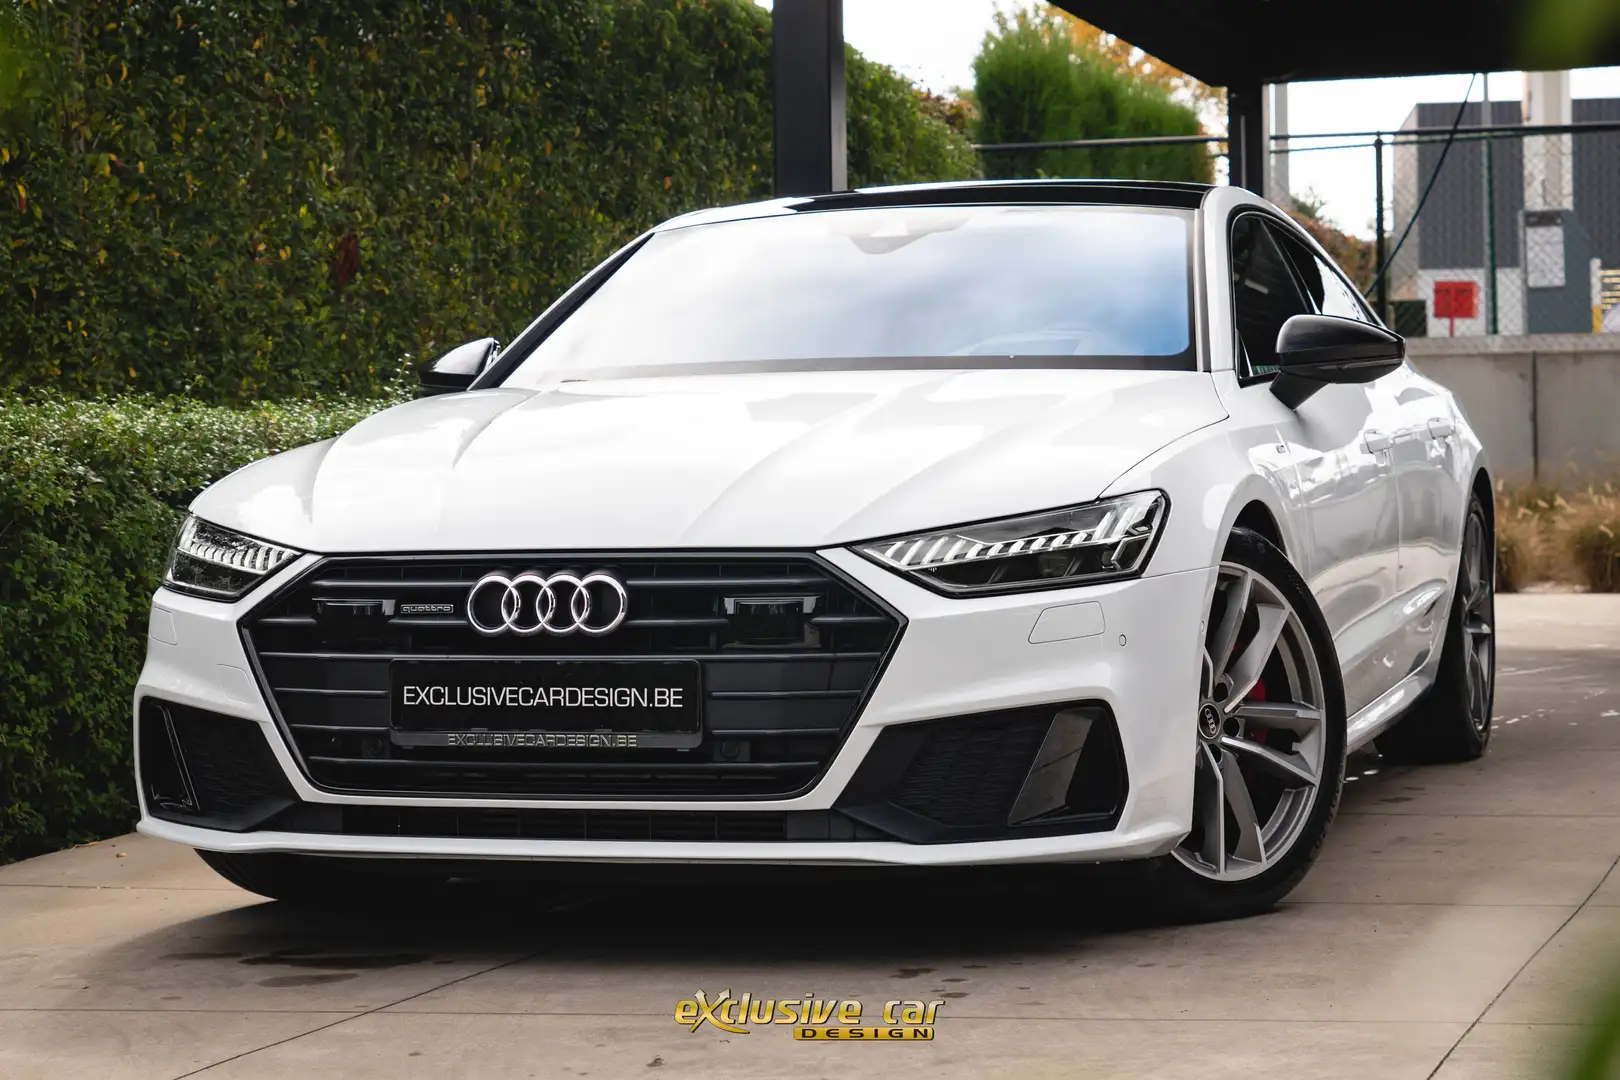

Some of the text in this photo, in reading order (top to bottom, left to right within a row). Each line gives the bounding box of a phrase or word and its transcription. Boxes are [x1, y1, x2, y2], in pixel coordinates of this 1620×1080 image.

[402, 605, 451, 613] quattro
[403, 686, 683, 707] EXCLUSIVECARDESIGN.BE
[447, 733, 637, 747] EXCLUSIVECARDESIGN.BE
